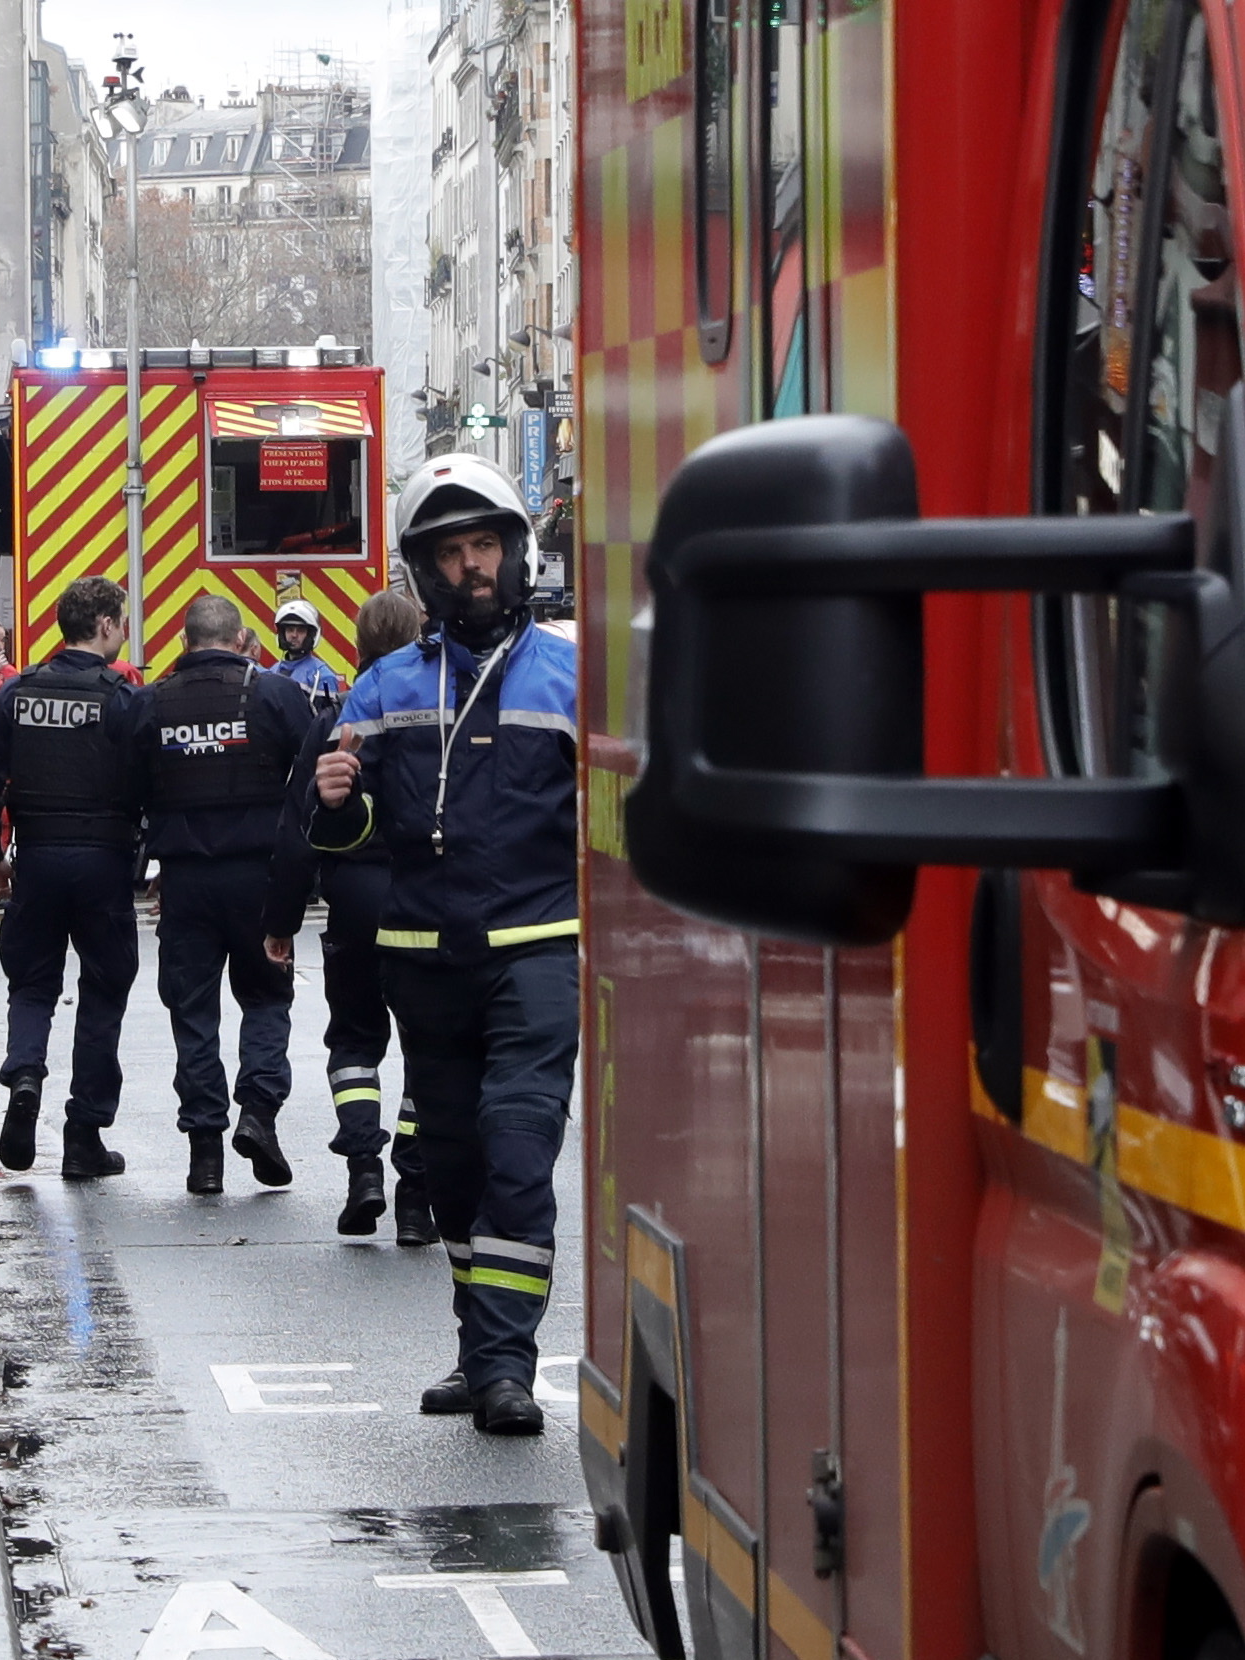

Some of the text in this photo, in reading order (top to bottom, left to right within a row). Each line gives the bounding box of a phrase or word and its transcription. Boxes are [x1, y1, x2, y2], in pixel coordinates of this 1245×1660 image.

[527, 414, 542, 507] PRESSING
[16, 698, 100, 726] POLICE
[161, 721, 247, 745] POLICE
[183, 744, 225, 756] VTT 10
